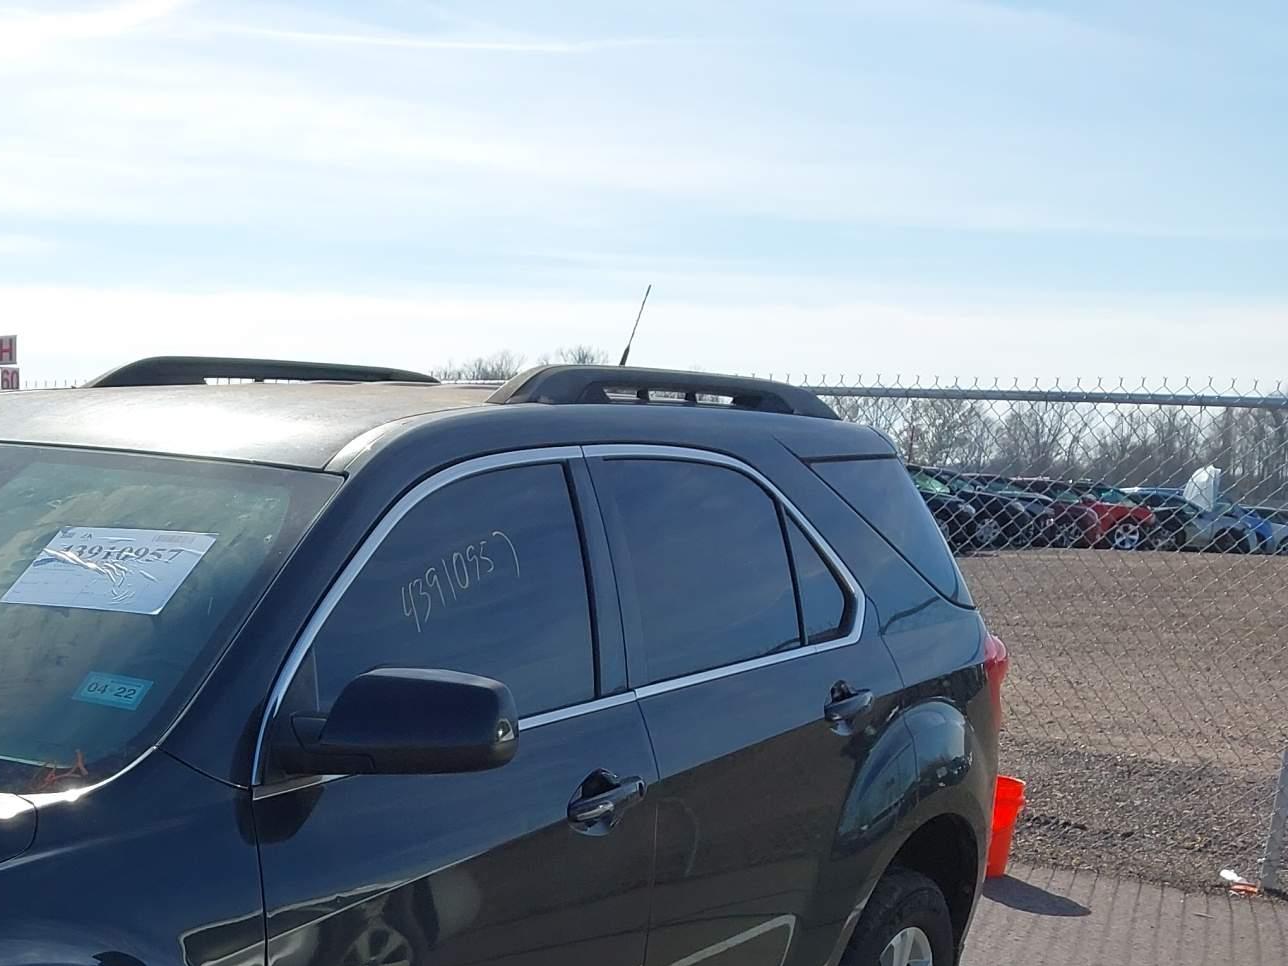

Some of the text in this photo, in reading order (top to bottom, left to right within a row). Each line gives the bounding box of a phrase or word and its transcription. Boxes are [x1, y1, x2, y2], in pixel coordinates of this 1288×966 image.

[0, 338, 13, 361] H
[401, 531, 520, 633] 43910957
[87, 682, 109, 695] 04
[113, 686, 137, 700] 22
